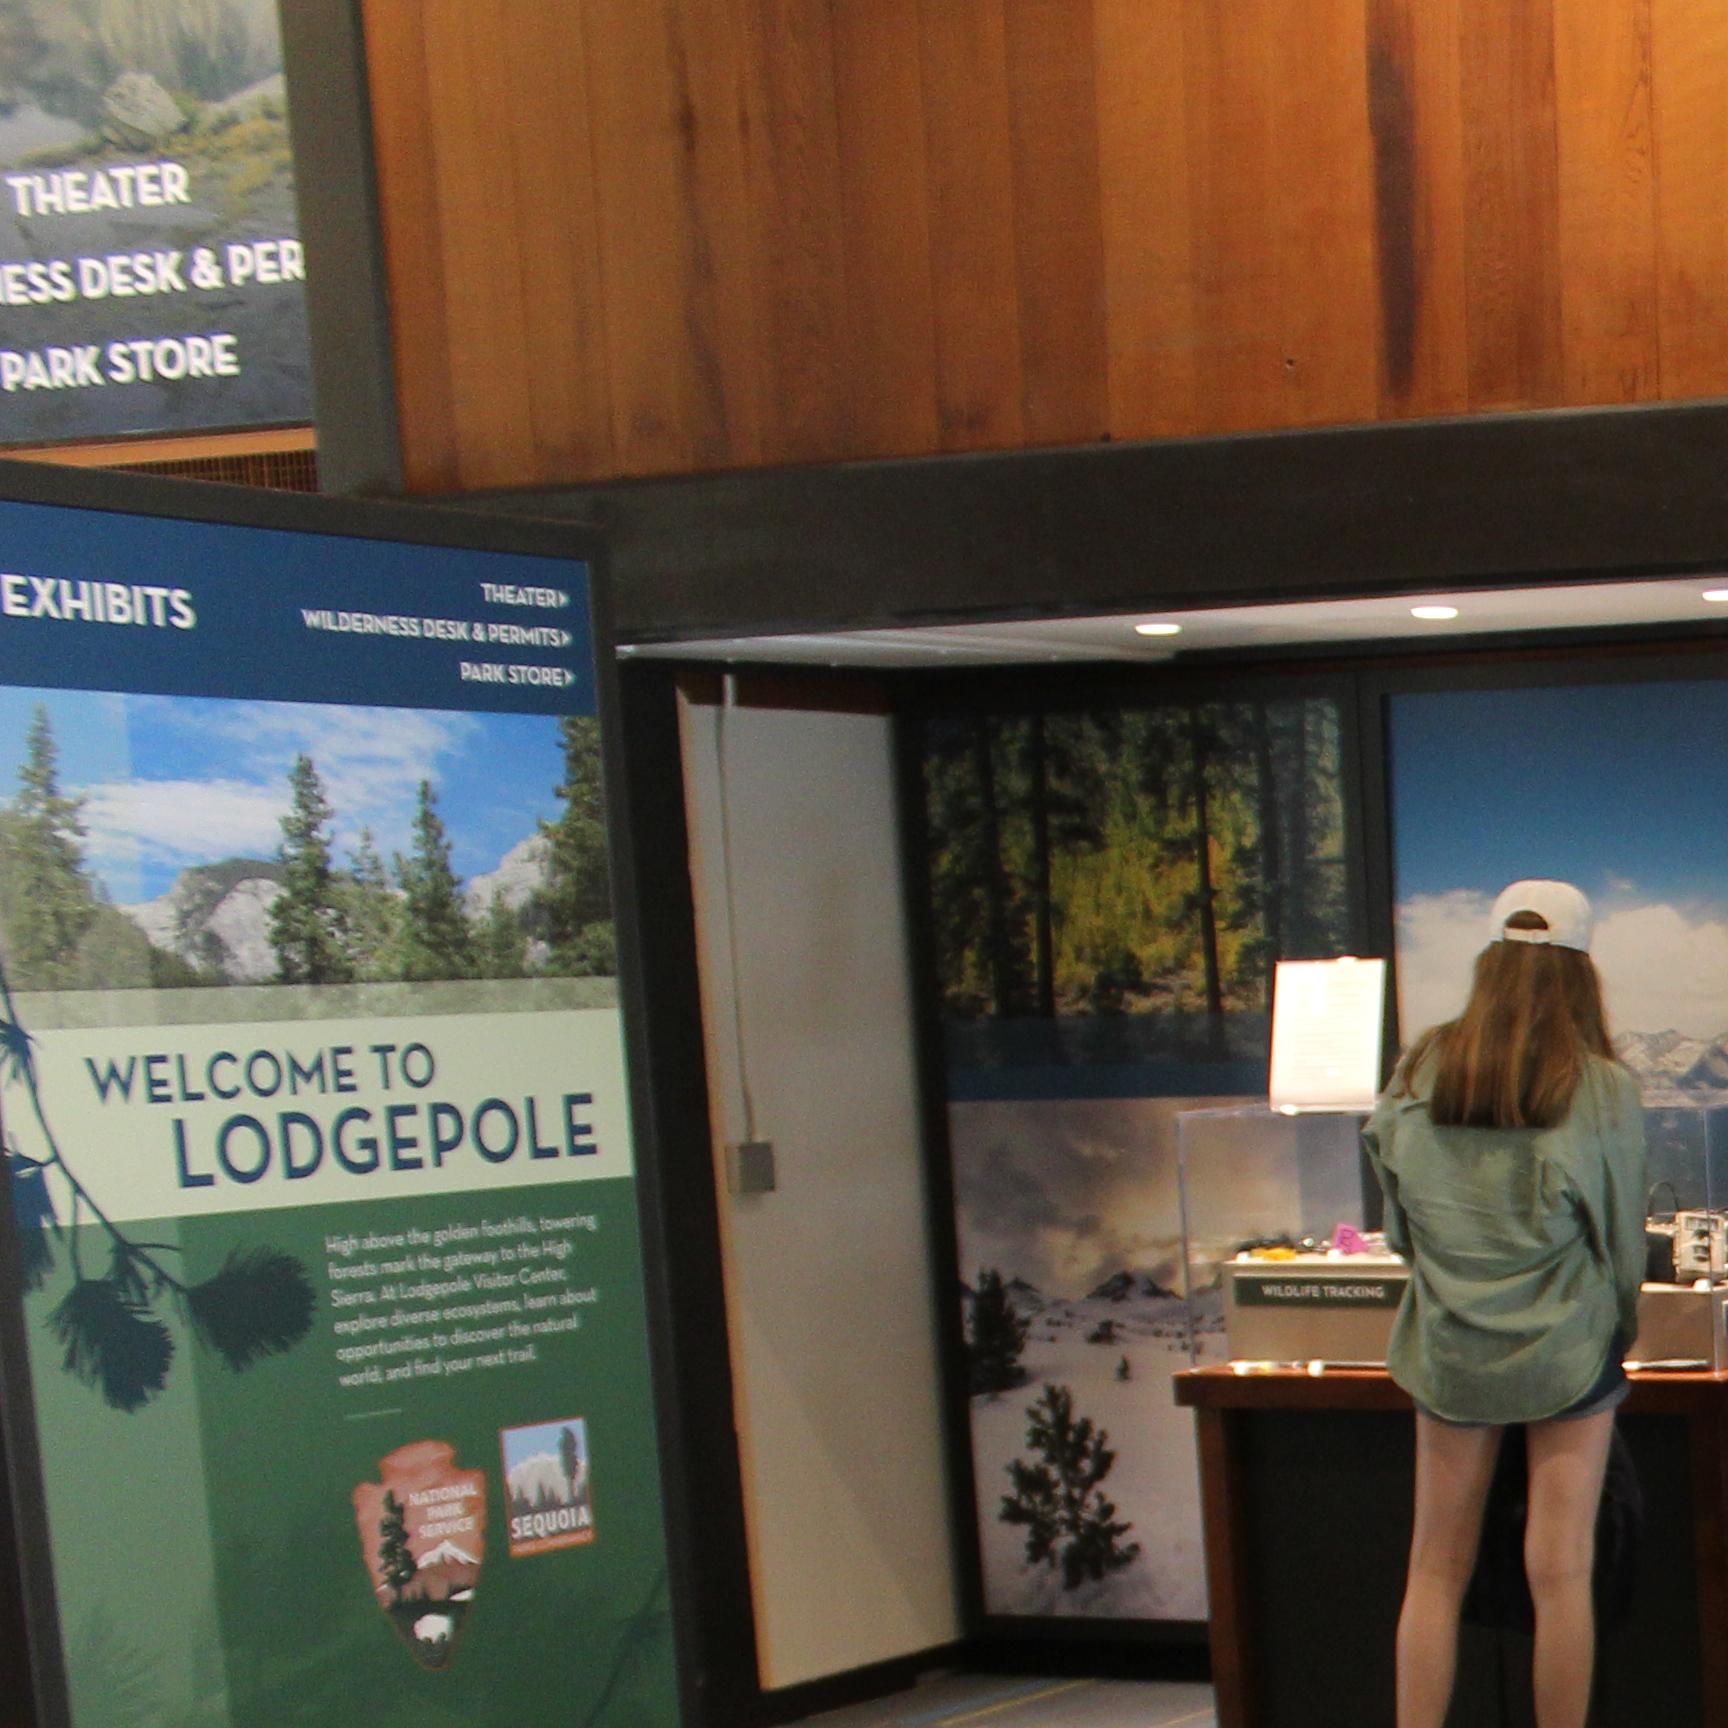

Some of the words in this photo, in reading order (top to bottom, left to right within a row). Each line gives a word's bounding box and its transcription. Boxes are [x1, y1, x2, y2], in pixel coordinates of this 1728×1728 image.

[5, 161, 192, 217] THEATER
[0, 260, 77, 306] ESS
[78, 250, 187, 301] DESK
[190, 247, 225, 291] &
[0, 345, 106, 392] PARK
[107, 333, 241, 384] STORE
[0, 573, 197, 630] EXHIBITS
[480, 582, 558, 609] THEATER
[302, 608, 420, 638] WILDERNESS
[422, 618, 470, 641] DESK
[472, 623, 485, 641] &
[488, 624, 562, 648] PERMITS
[460, 661, 506, 683] PARK
[508, 664, 561, 687] STORE
[85, 1045, 355, 1105] WELCOME
[370, 1041, 436, 1091] TO
[172, 1092, 599, 1189] LODGEPOLE
[325, 1234, 359, 1257] High
[361, 1231, 405, 1250] above
[407, 1227, 431, 1246] the
[433, 1222, 478, 1247] golden
[540, 1214, 598, 1233] towering
[328, 1259, 378, 1280] forests
[381, 1254, 415, 1274] mark
[417, 1252, 441, 1271] the
[443, 1249, 499, 1272] gateway
[501, 1247, 516, 1262] to
[518, 1242, 540, 1259] the
[542, 1238, 573, 1260] High
[380, 1285, 399, 1301] At
[401, 1276, 472, 1301] Lodgepole
[473, 1271, 516, 1290] Visitor
[1262, 1284, 1321, 1298] WILDLIFE
[1324, 1284, 1385, 1299] TRACKING
[334, 1313, 387, 1336] explore
[390, 1307, 440, 1328] diverse
[524, 1291, 557, 1310] learn
[560, 1286, 598, 1306] about
[336, 1338, 432, 1363] opportunities
[450, 1327, 506, 1346] discover
[508, 1319, 531, 1337] the
[533, 1312, 578, 1334] natural
[385, 1361, 412, 1381] and
[414, 1356, 441, 1377] find
[443, 1356, 473, 1377] your
[476, 1351, 506, 1368] next
[409, 1482, 478, 1507] NATIONAL
[427, 1502, 466, 1521] PARK
[418, 1515, 475, 1540] SERVICE
[510, 1504, 592, 1540] SEQUOIA
